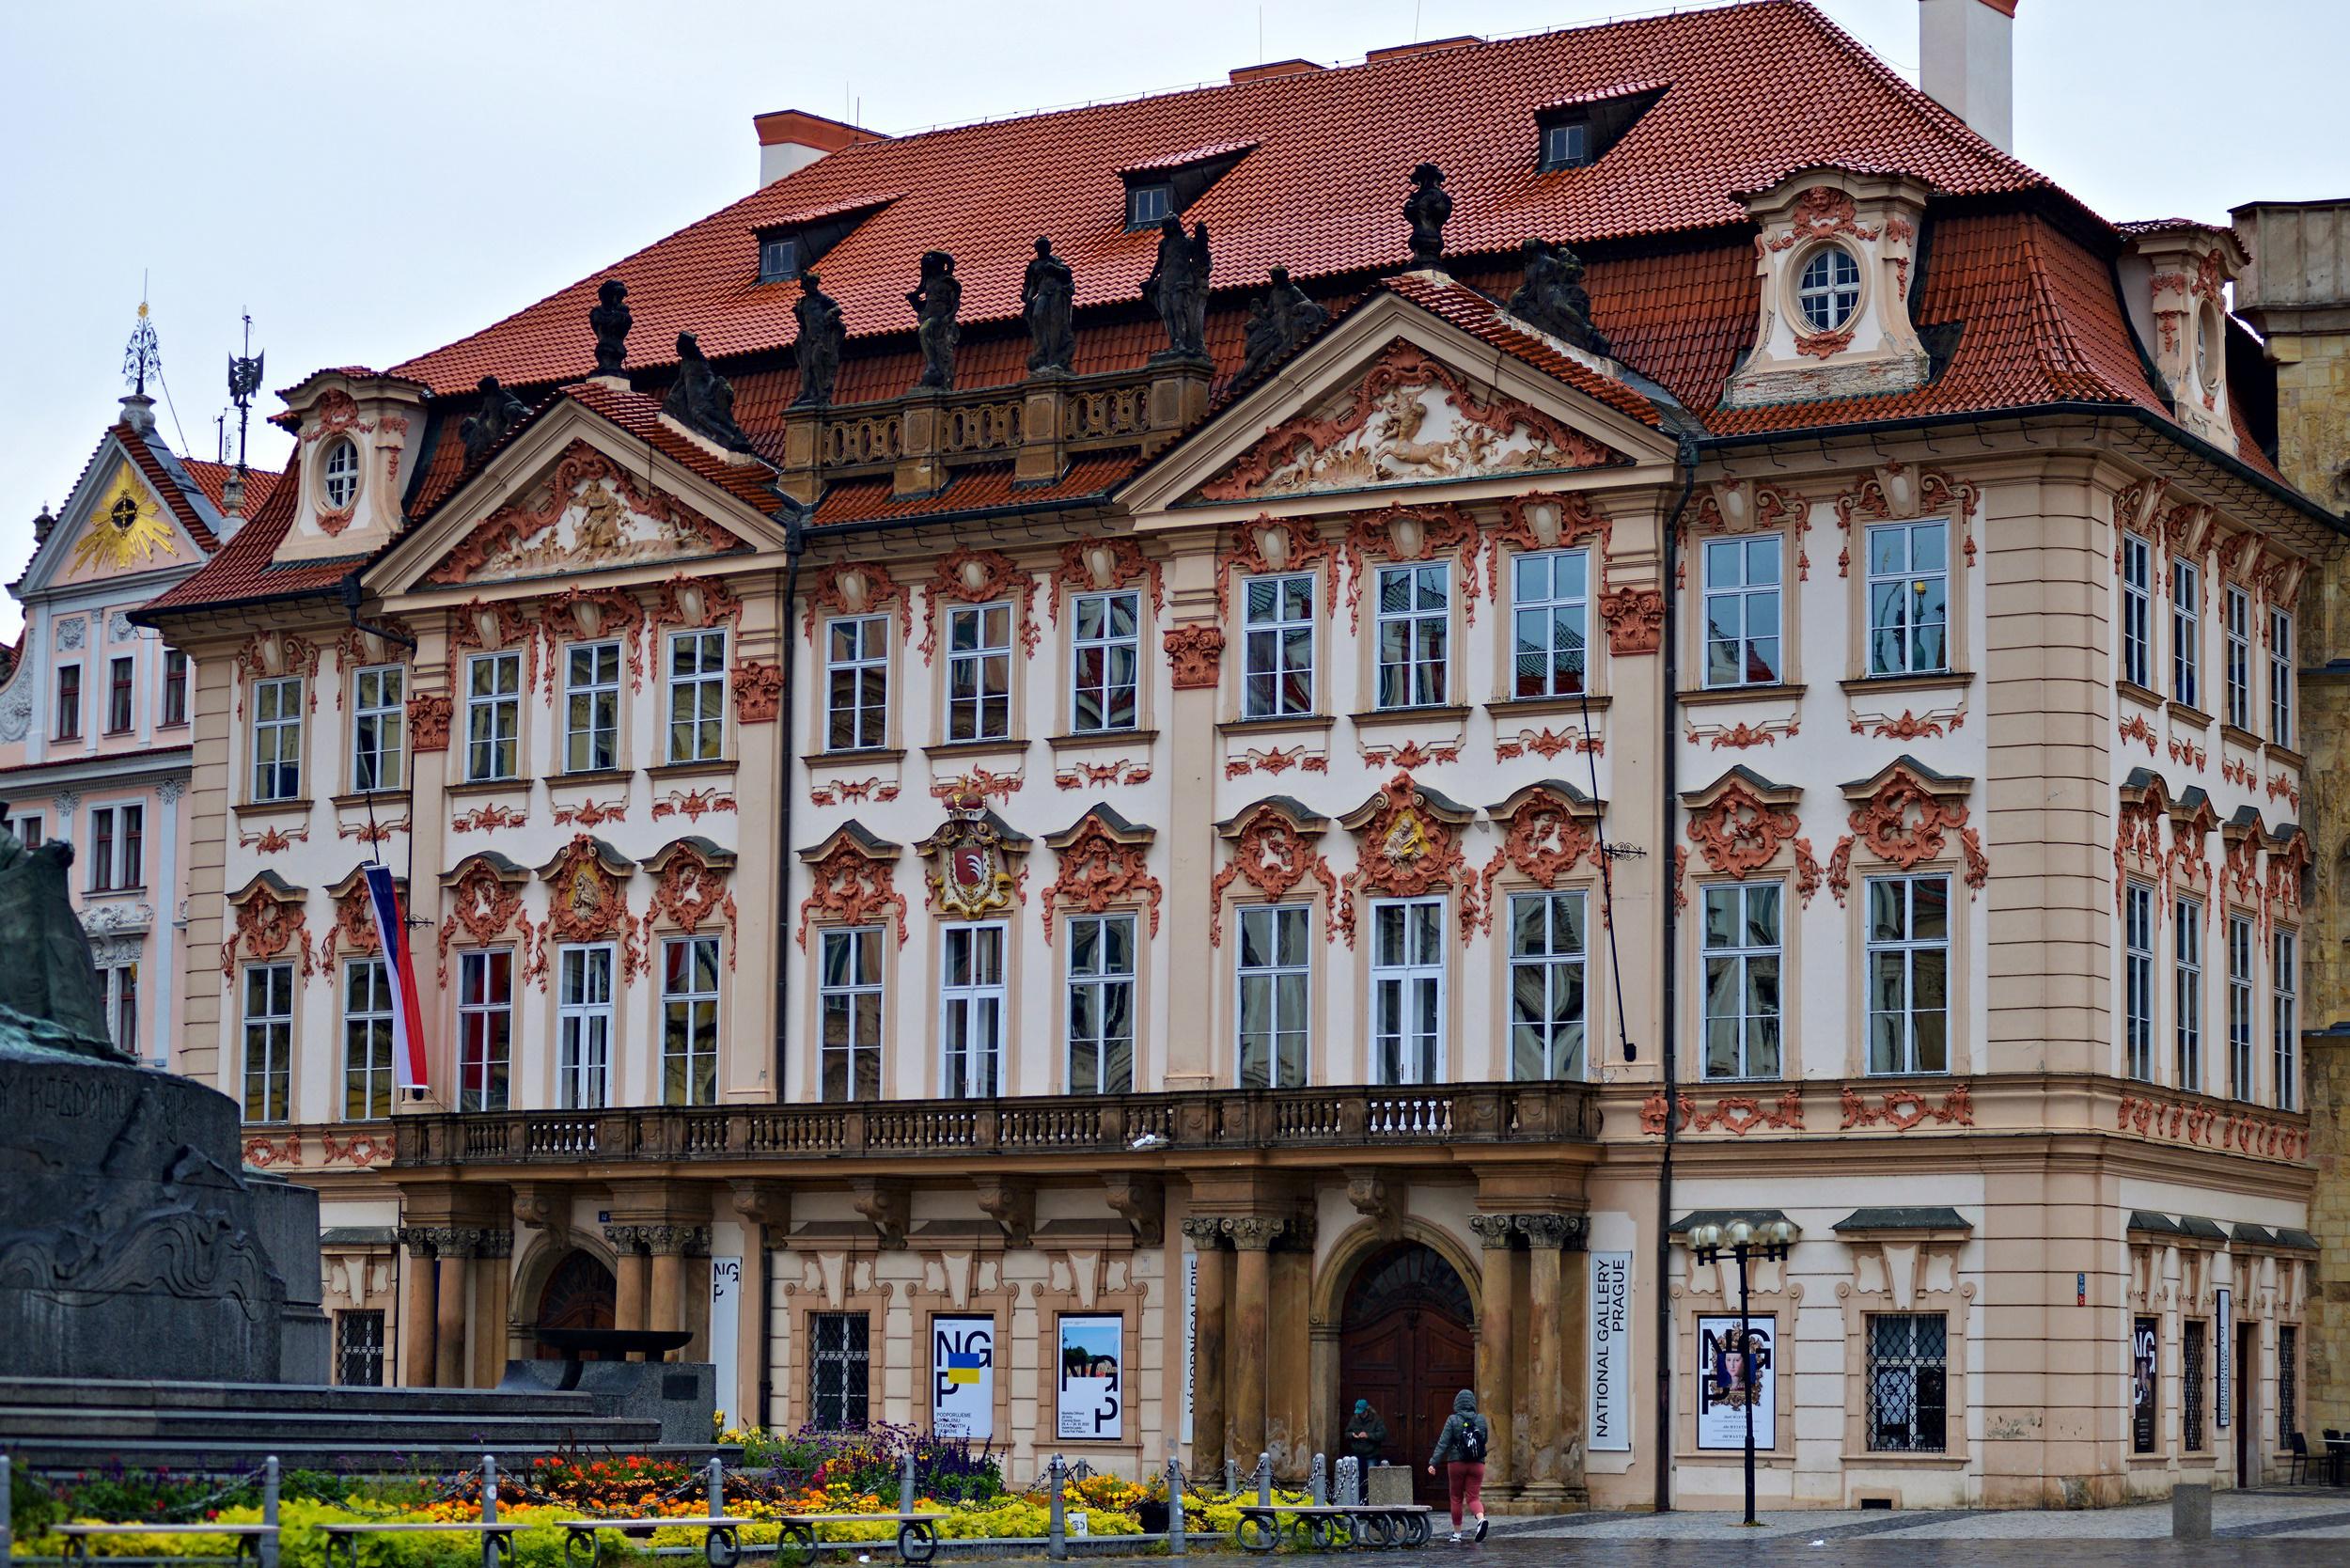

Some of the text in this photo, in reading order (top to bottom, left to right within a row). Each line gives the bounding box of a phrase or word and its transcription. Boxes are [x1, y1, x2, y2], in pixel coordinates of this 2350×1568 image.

[714, 1262, 739, 1282] NG
[713, 1284, 724, 1303] P
[1612, 1260, 1625, 1332] PRAGUE
[937, 1331, 993, 1369] NG
[1596, 1260, 1609, 1437] NATIONAL GALLERY
[1702, 1328, 1771, 1370] NG
[937, 1372, 959, 1408] P
[1062, 1355, 1118, 1392] NG
[1702, 1374, 1731, 1415] P
[1095, 1397, 1118, 1434] P
